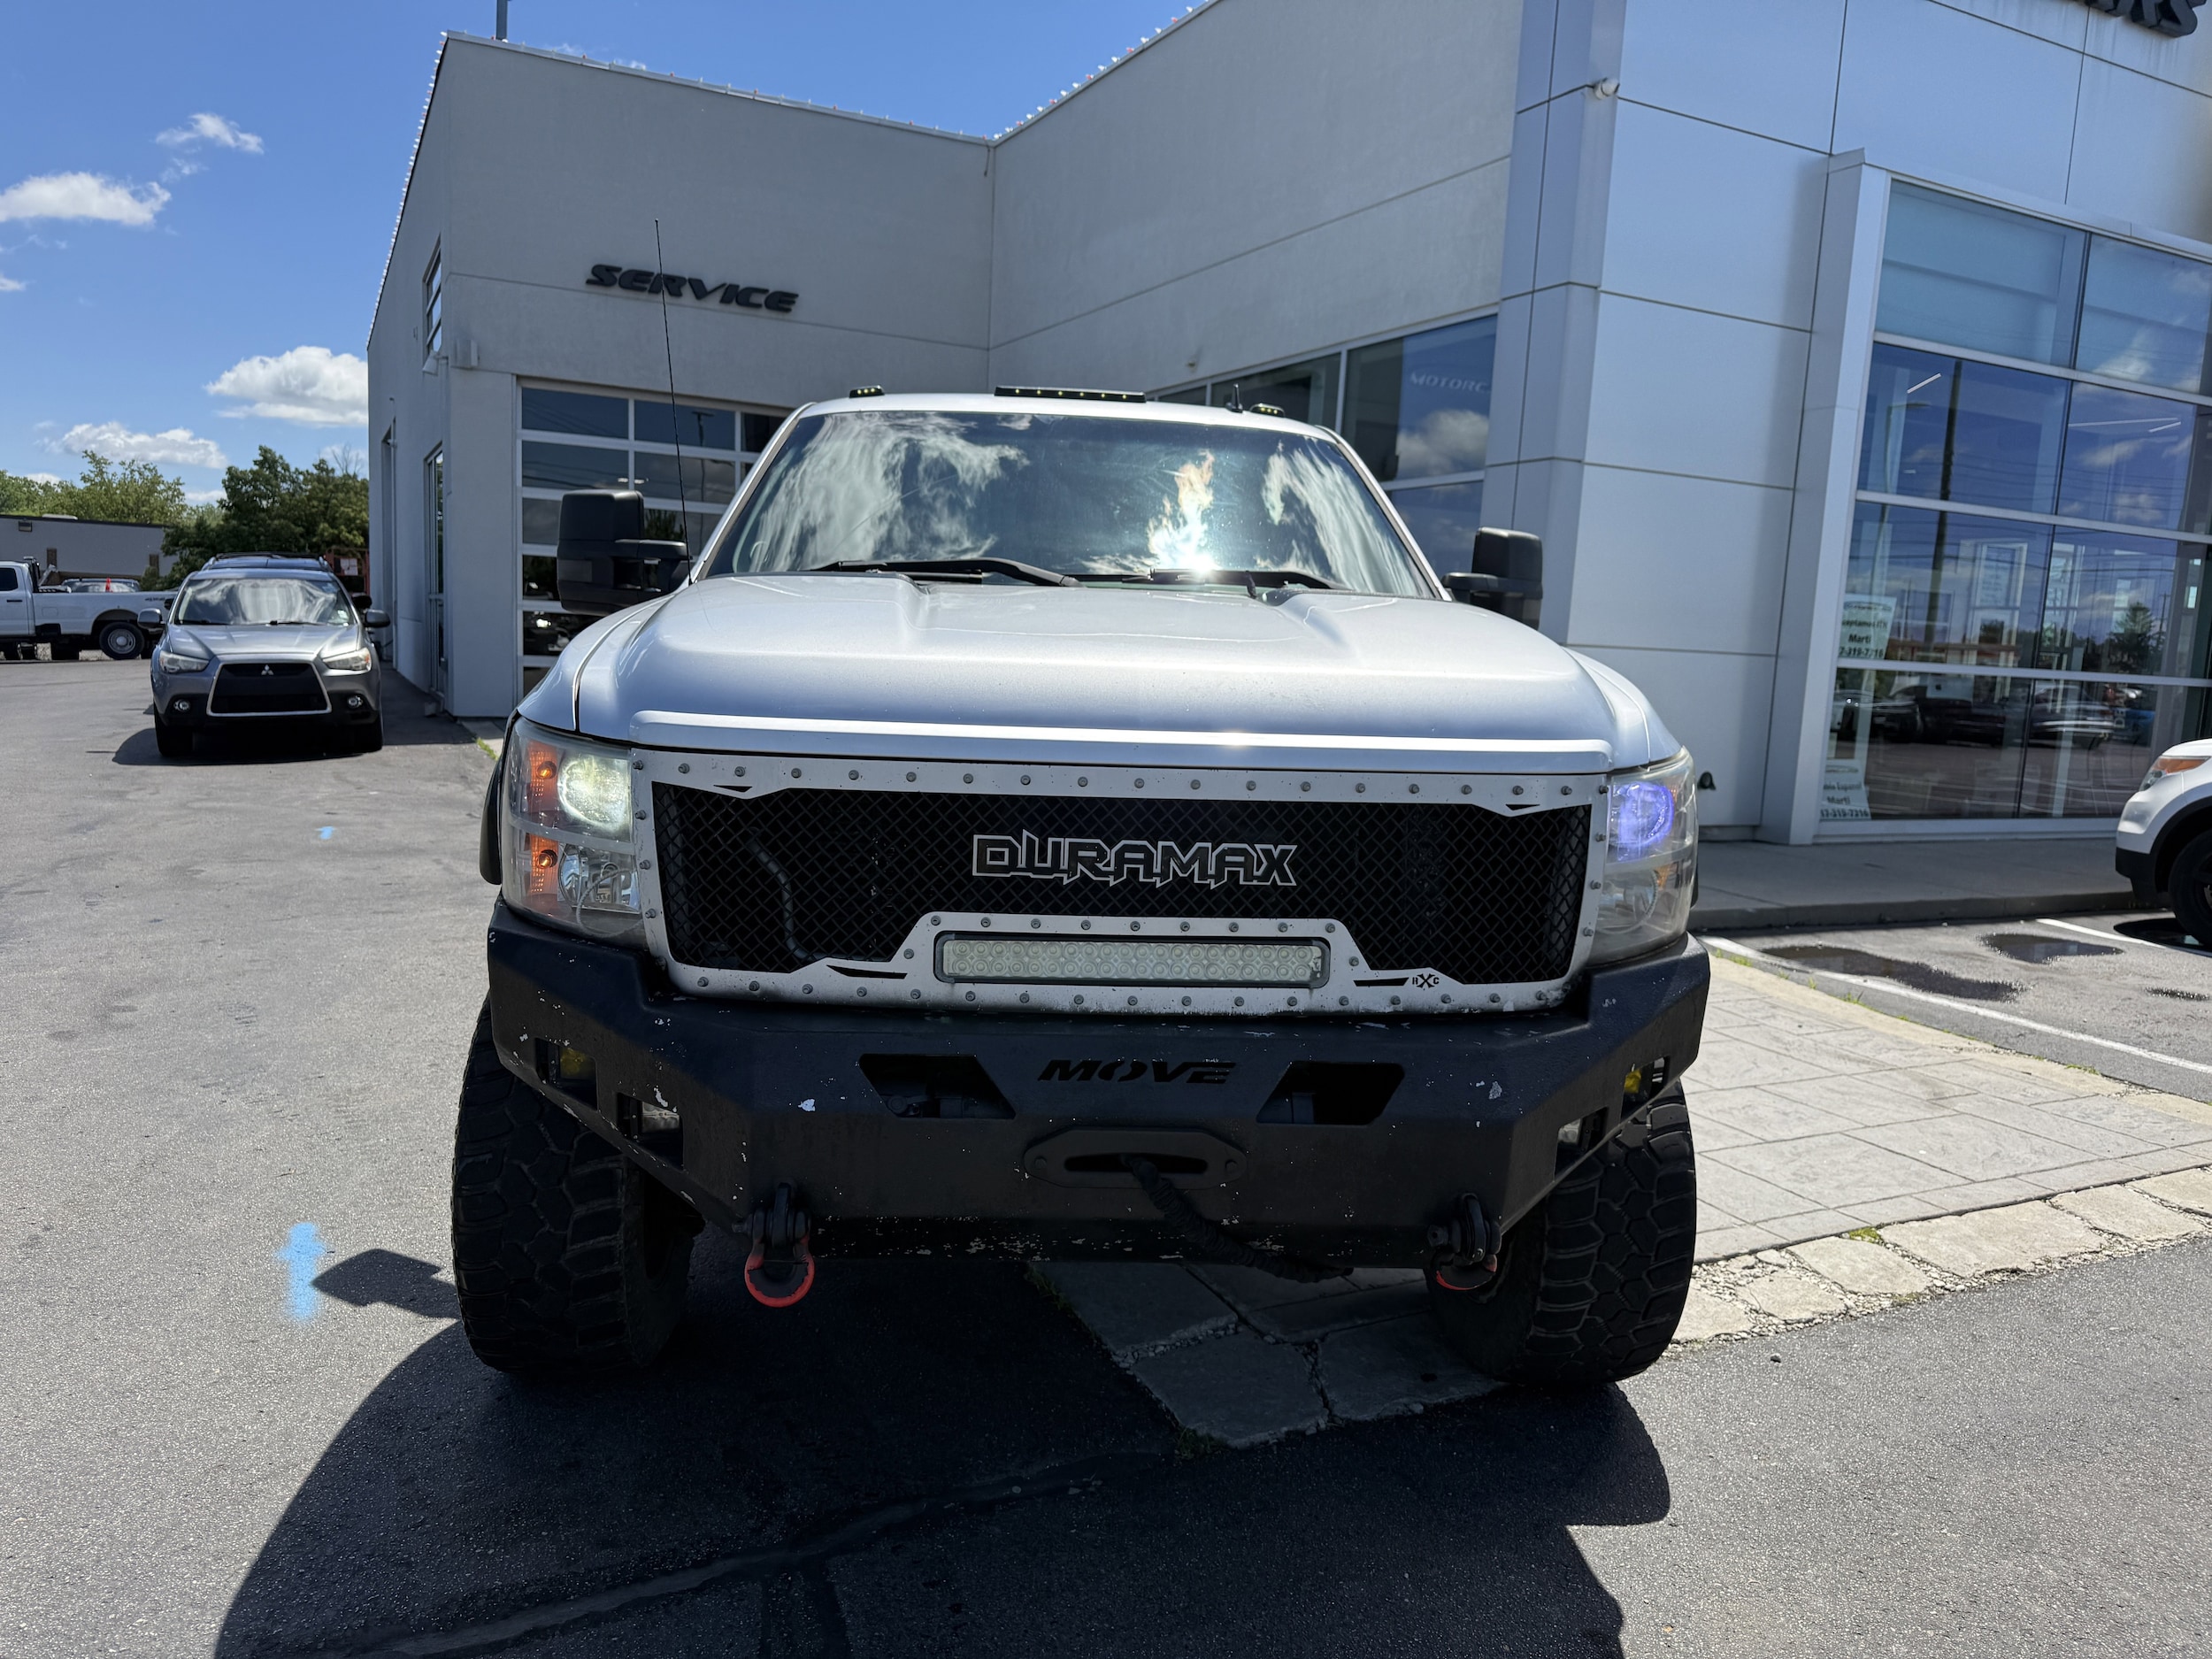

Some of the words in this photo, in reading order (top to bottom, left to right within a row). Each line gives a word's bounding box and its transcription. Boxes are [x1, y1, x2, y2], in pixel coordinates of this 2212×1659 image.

[586, 264, 799, 312] SERVICE
[1410, 372, 1488, 394] MOTORC
[972, 829, 1297, 890] DURAMAX
[1037, 1059, 1236, 1084] MOVE
